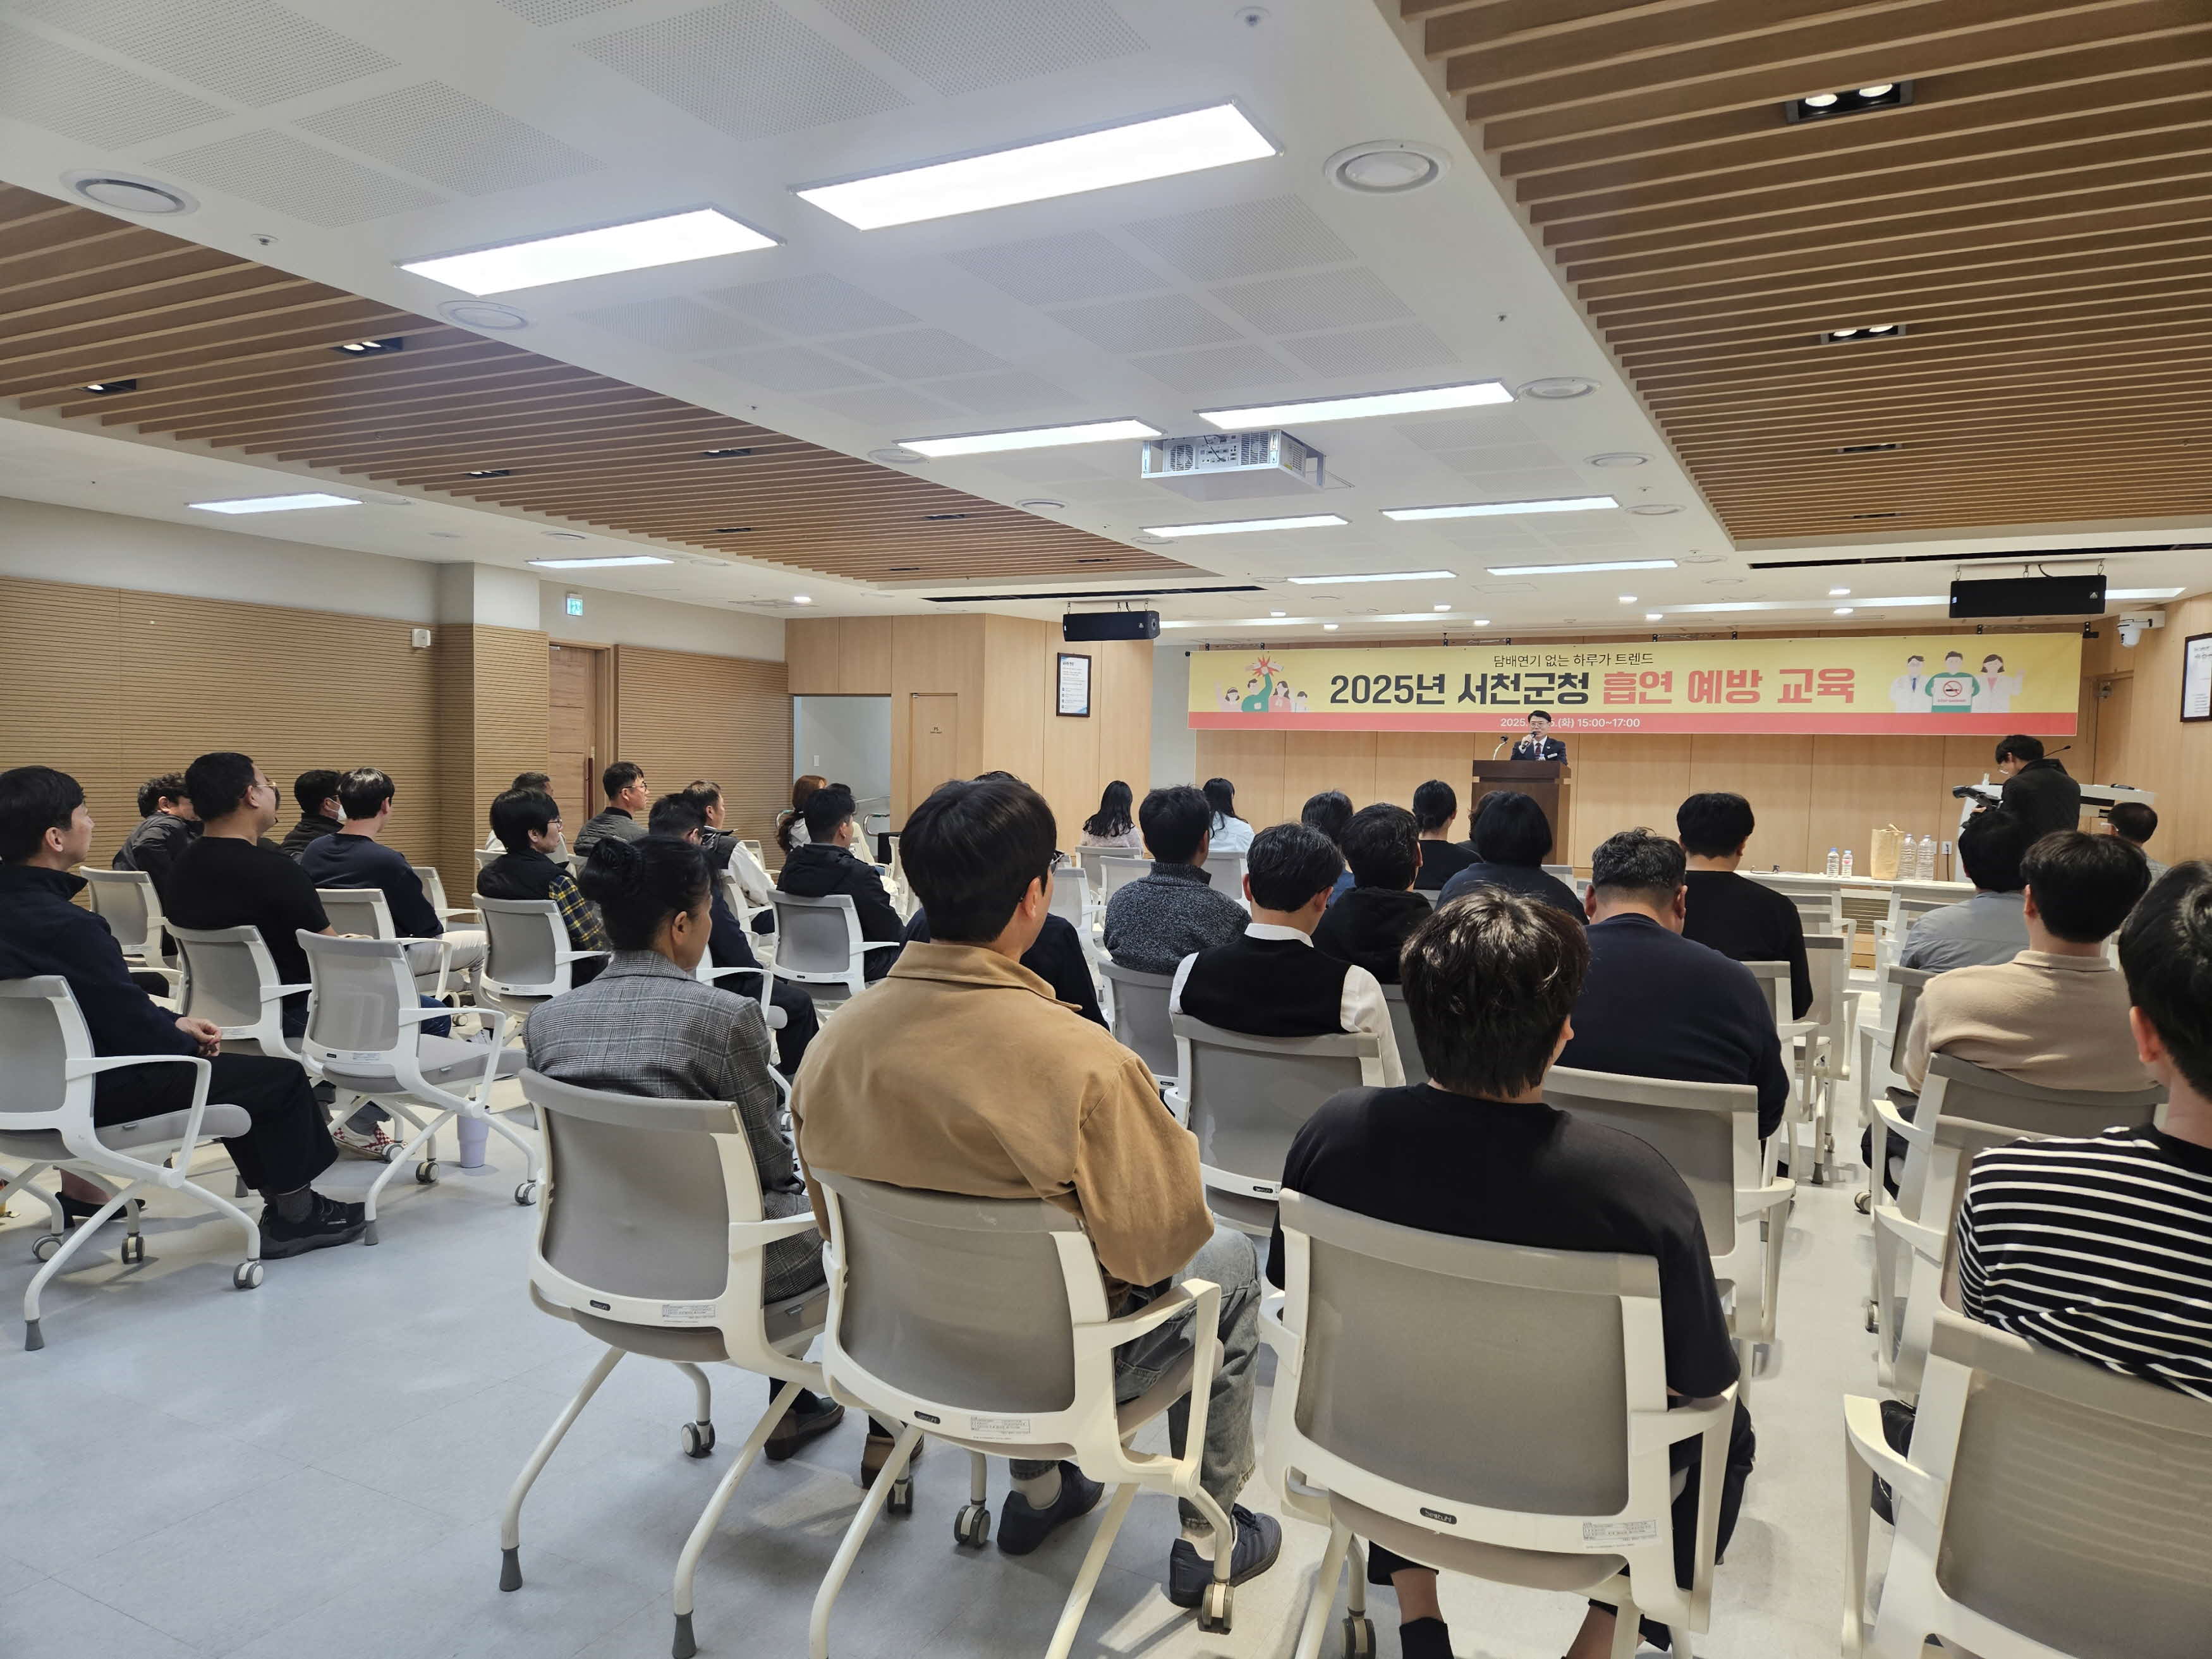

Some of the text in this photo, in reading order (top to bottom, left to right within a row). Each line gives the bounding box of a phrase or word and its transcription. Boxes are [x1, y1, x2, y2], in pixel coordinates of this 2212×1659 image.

[1494, 652, 1654, 667] 담배연기 없는 하루가 트렌드
[1330, 668, 1856, 705] 2025년 서천군청 흡연 예방 교육
[1577, 718, 1641, 727] 15:00~17:00
